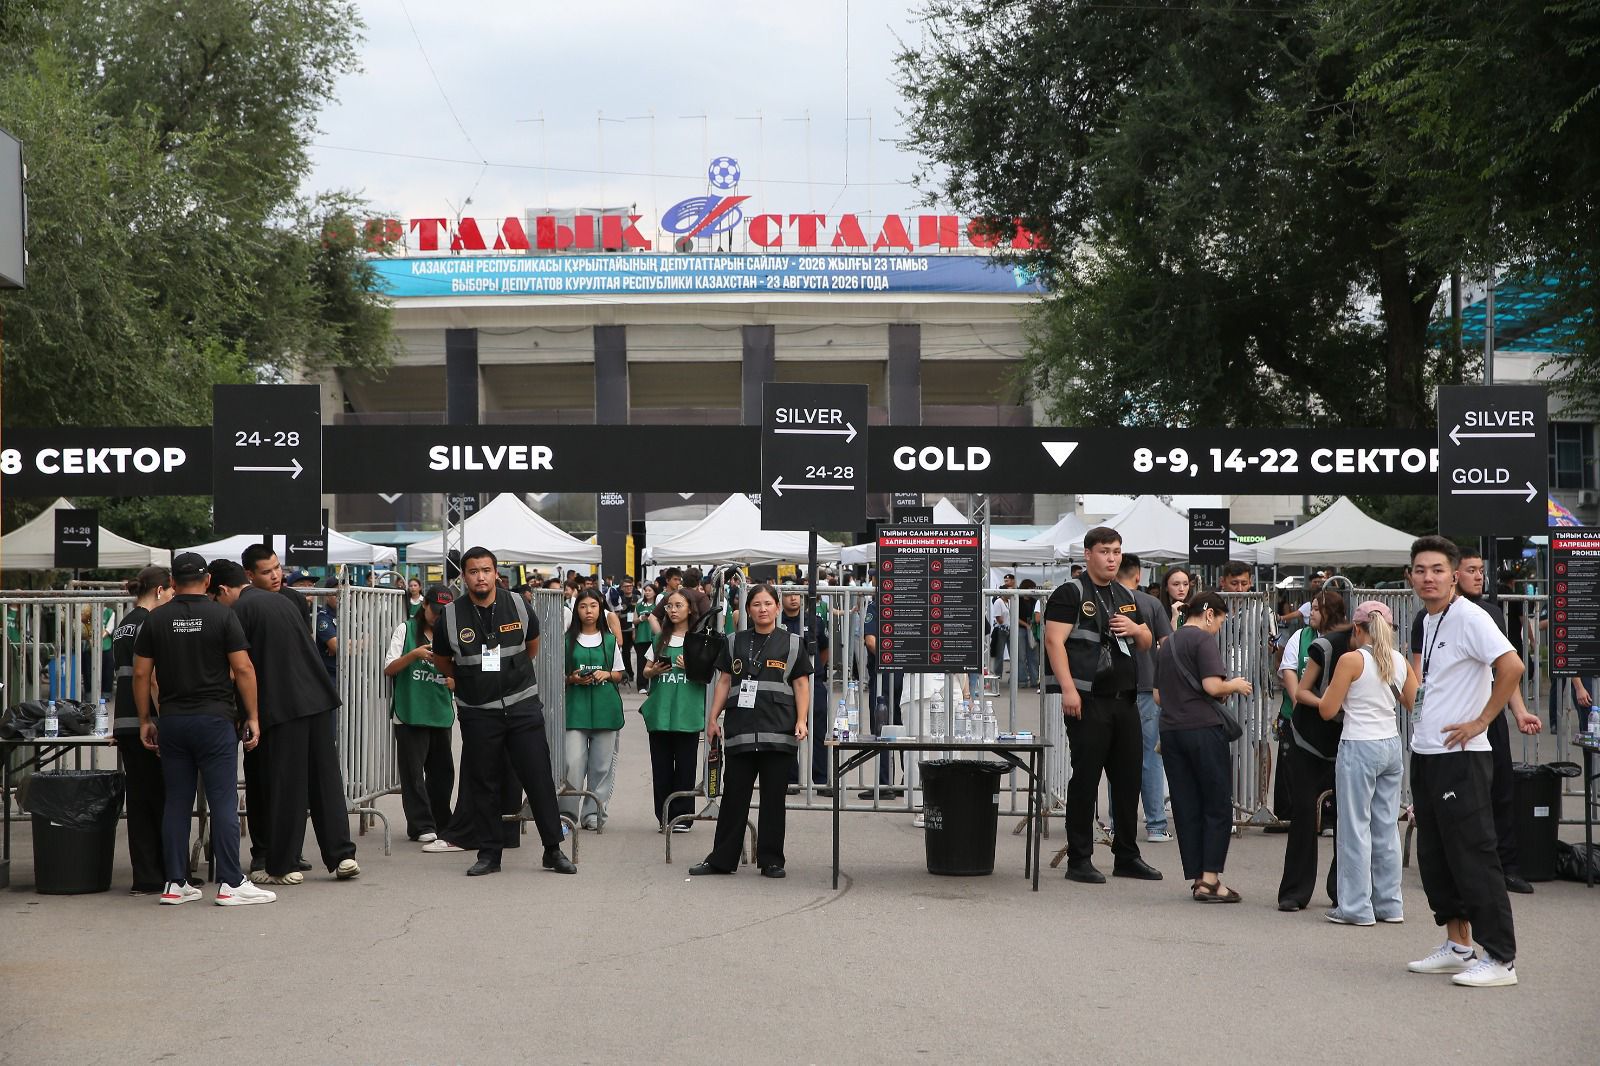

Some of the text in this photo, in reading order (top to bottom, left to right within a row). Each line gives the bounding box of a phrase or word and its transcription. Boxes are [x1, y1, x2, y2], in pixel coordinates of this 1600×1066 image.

[320, 214, 651, 252] РТАЛЫҚ
[412, 260, 474, 275] ҚАЗАҚСТАН
[476, 259, 562, 273] РЕСПУБЛИКАСЫ
[564, 256, 658, 273] ҚҰРЫЛТАЙЫНЫҢ
[660, 257, 744, 272] ДЕПУТАТТАРЫН
[746, 255, 789, 271] САЙЛАУ
[798, 258, 826, 271] 2026
[828, 258, 872, 271] ЖЫЛҒЫ
[874, 258, 888, 271] 23
[889, 258, 928, 271] ТАМЫЗ
[451, 278, 499, 292] ВЫБОРЫ
[501, 277, 563, 292] ДЕПУТАТОВ
[565, 276, 620, 290] КУРУЛТАЯ
[622, 275, 693, 290] РЕСПУБЛИКИ
[695, 275, 757, 289] КАЗАХСТАН
[766, 275, 781, 289] 23
[782, 275, 830, 289] АВГУСТА
[831, 275, 859, 289] 2026
[860, 275, 890, 291] ГОДА
[775, 407, 843, 425] SILVER
[1464, 410, 1535, 427] SILVER
[235, 431, 300, 447] 24-28
[35, 447, 187, 475] СЕКТОР
[429, 445, 554, 471] SILVER
[893, 446, 991, 471] GOLD
[1133, 447, 1199, 477] 8-9,
[1209, 448, 1299, 473] 14-22
[805, 465, 855, 479] 24-28
[1452, 467, 1510, 484] GOLD
[63, 526, 91, 535] 24-28
[1202, 538, 1226, 546] GOLD
[412, 669, 444, 681] STAF
[657, 672, 688, 684] TAF
